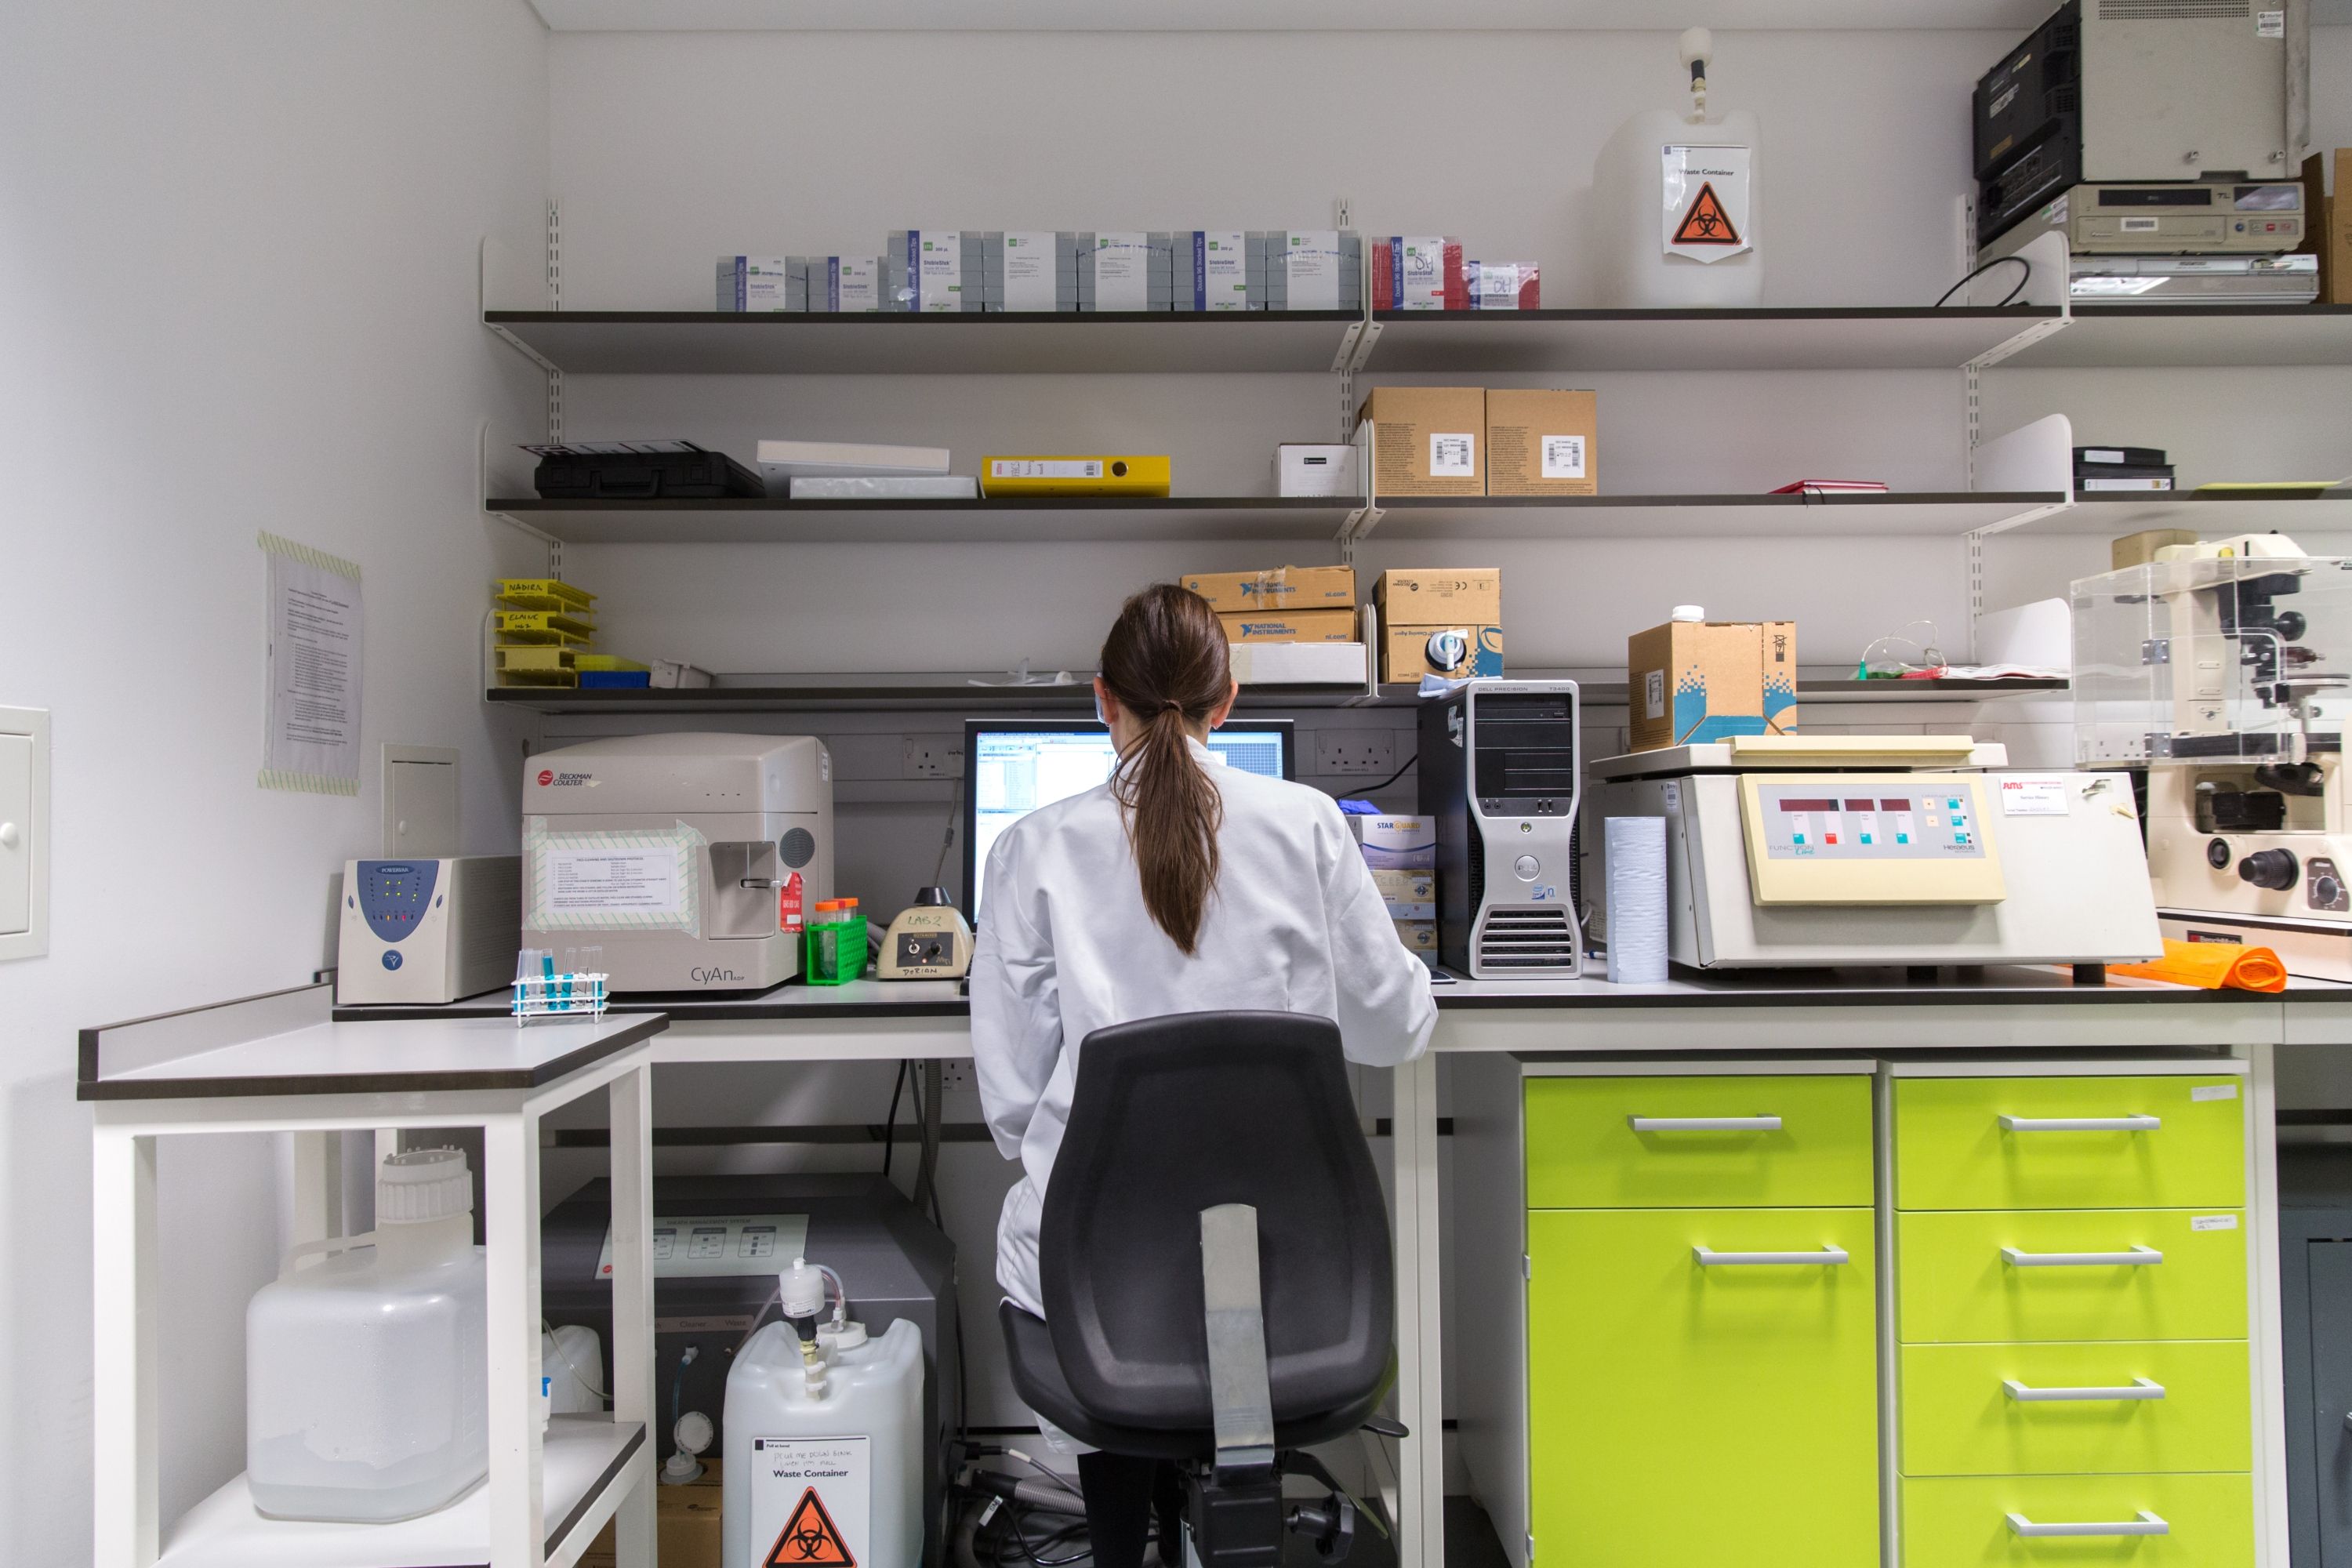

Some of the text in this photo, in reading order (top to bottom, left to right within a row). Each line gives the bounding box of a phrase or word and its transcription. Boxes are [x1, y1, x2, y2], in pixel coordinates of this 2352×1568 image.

[931, 916, 942, 926] 2
[691, 967, 733, 985] CyAn
[804, 1469, 848, 1478] Container
